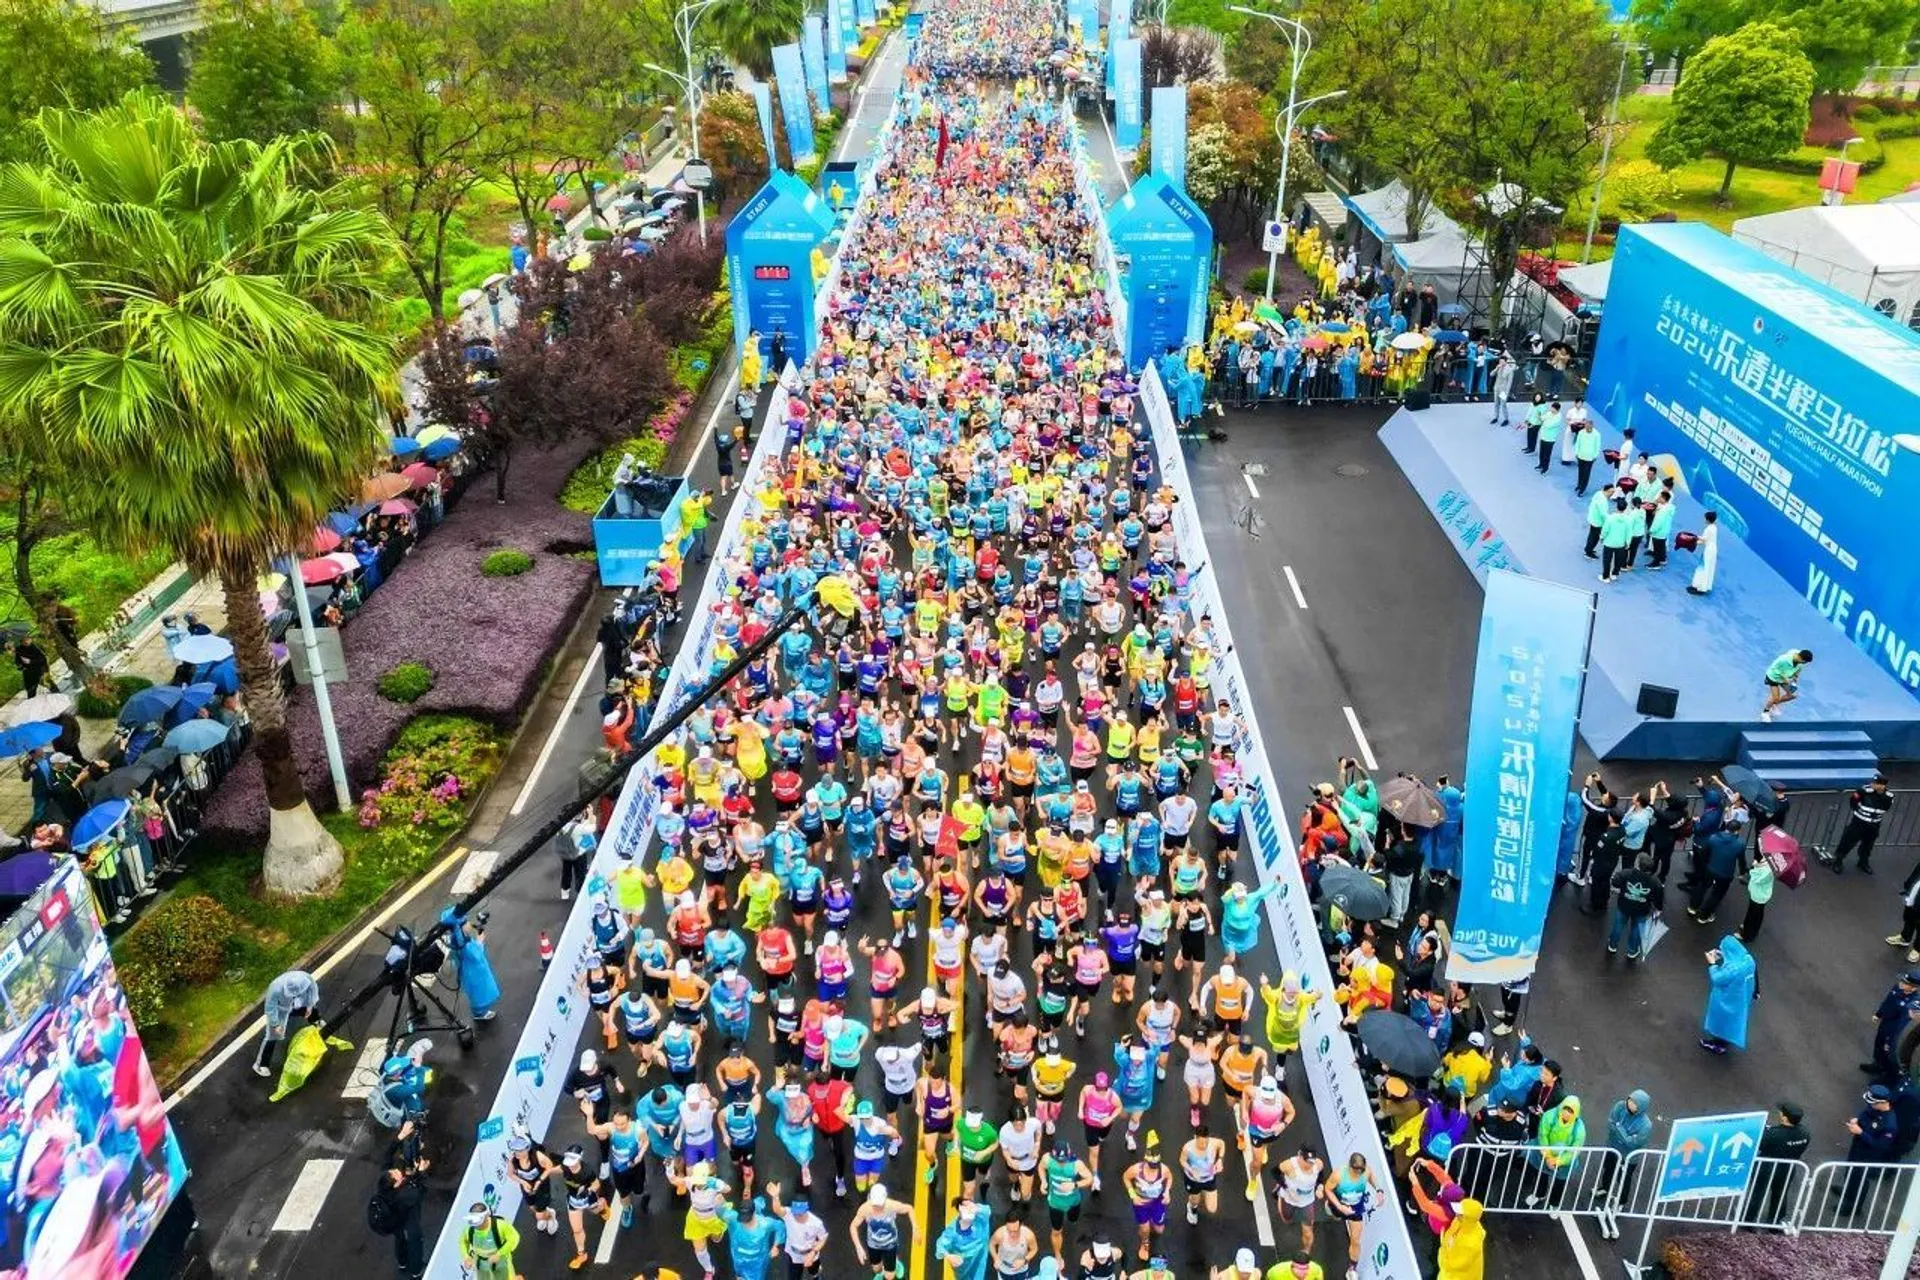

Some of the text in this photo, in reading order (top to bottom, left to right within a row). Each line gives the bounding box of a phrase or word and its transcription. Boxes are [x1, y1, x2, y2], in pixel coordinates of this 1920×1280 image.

[745, 198, 769, 221] START
[1169, 198, 1193, 220] START
[1656, 314, 1714, 365] 2024
[1713, 329, 1898, 477] 乐清半程马拉松
[1835, 458, 1884, 498] MARATHON
[1806, 561, 1854, 632] YUE
[1716, 1162, 1745, 1176] 女子
